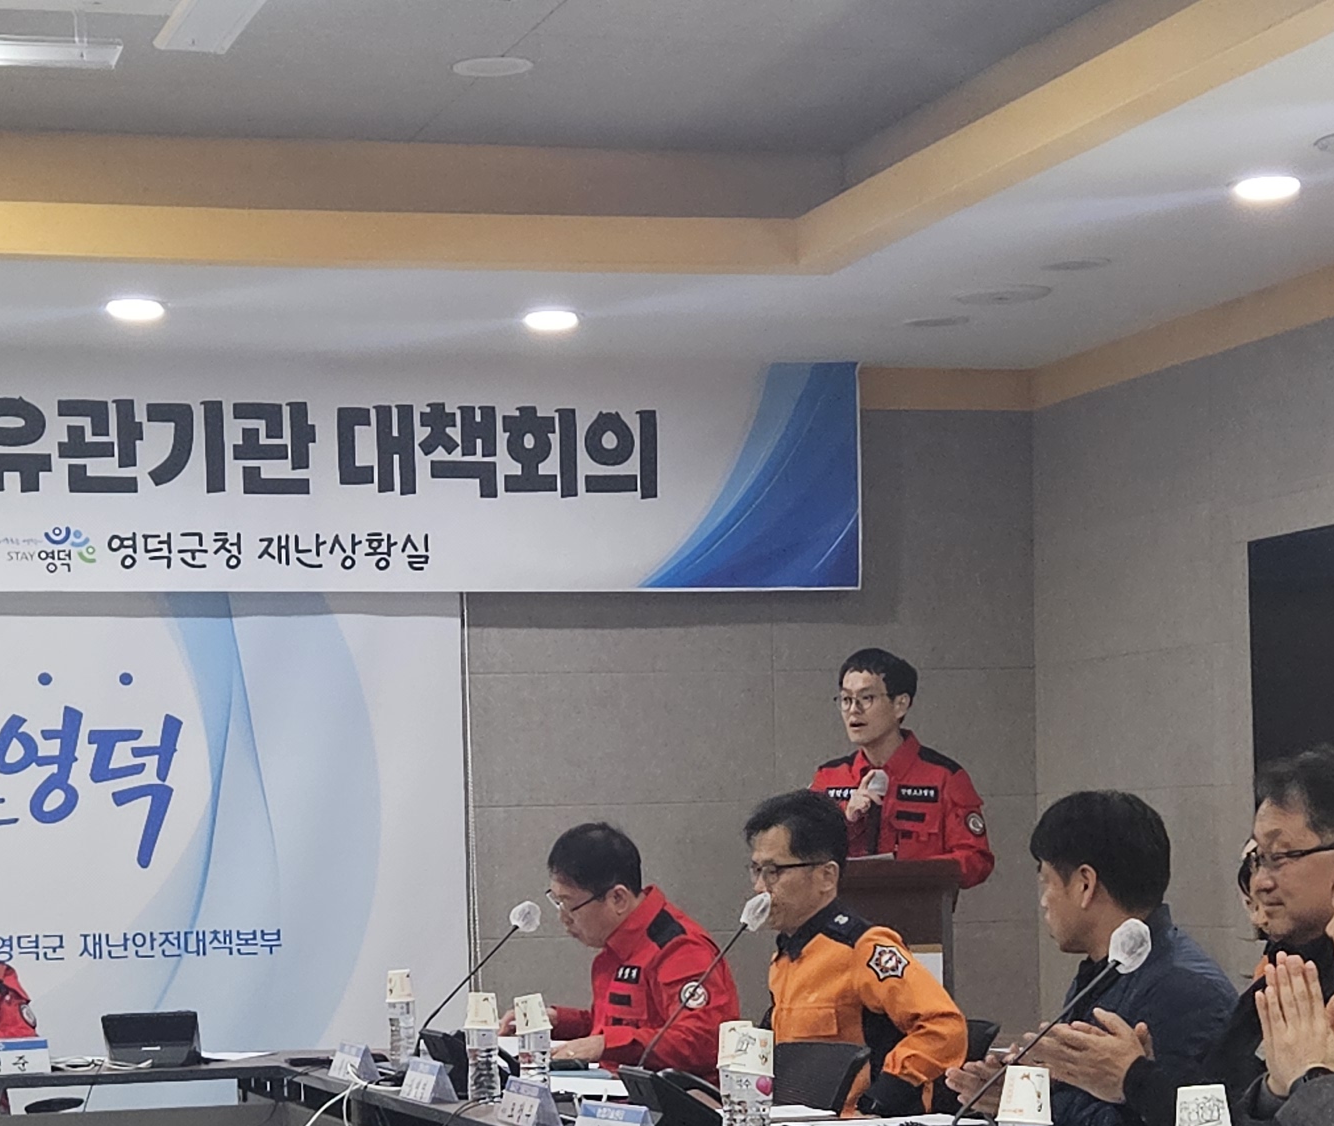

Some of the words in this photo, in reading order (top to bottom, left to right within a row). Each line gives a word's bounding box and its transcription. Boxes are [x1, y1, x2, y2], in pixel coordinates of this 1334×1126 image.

[336, 401, 658, 500] 대책회의
[7, 551, 35, 561] STAY
[37, 549, 71, 573] 영덕
[107, 531, 243, 570] 영덕군청
[257, 531, 431, 572] 재난상황실
[79, 928, 283, 960] 재난안전대책본부
